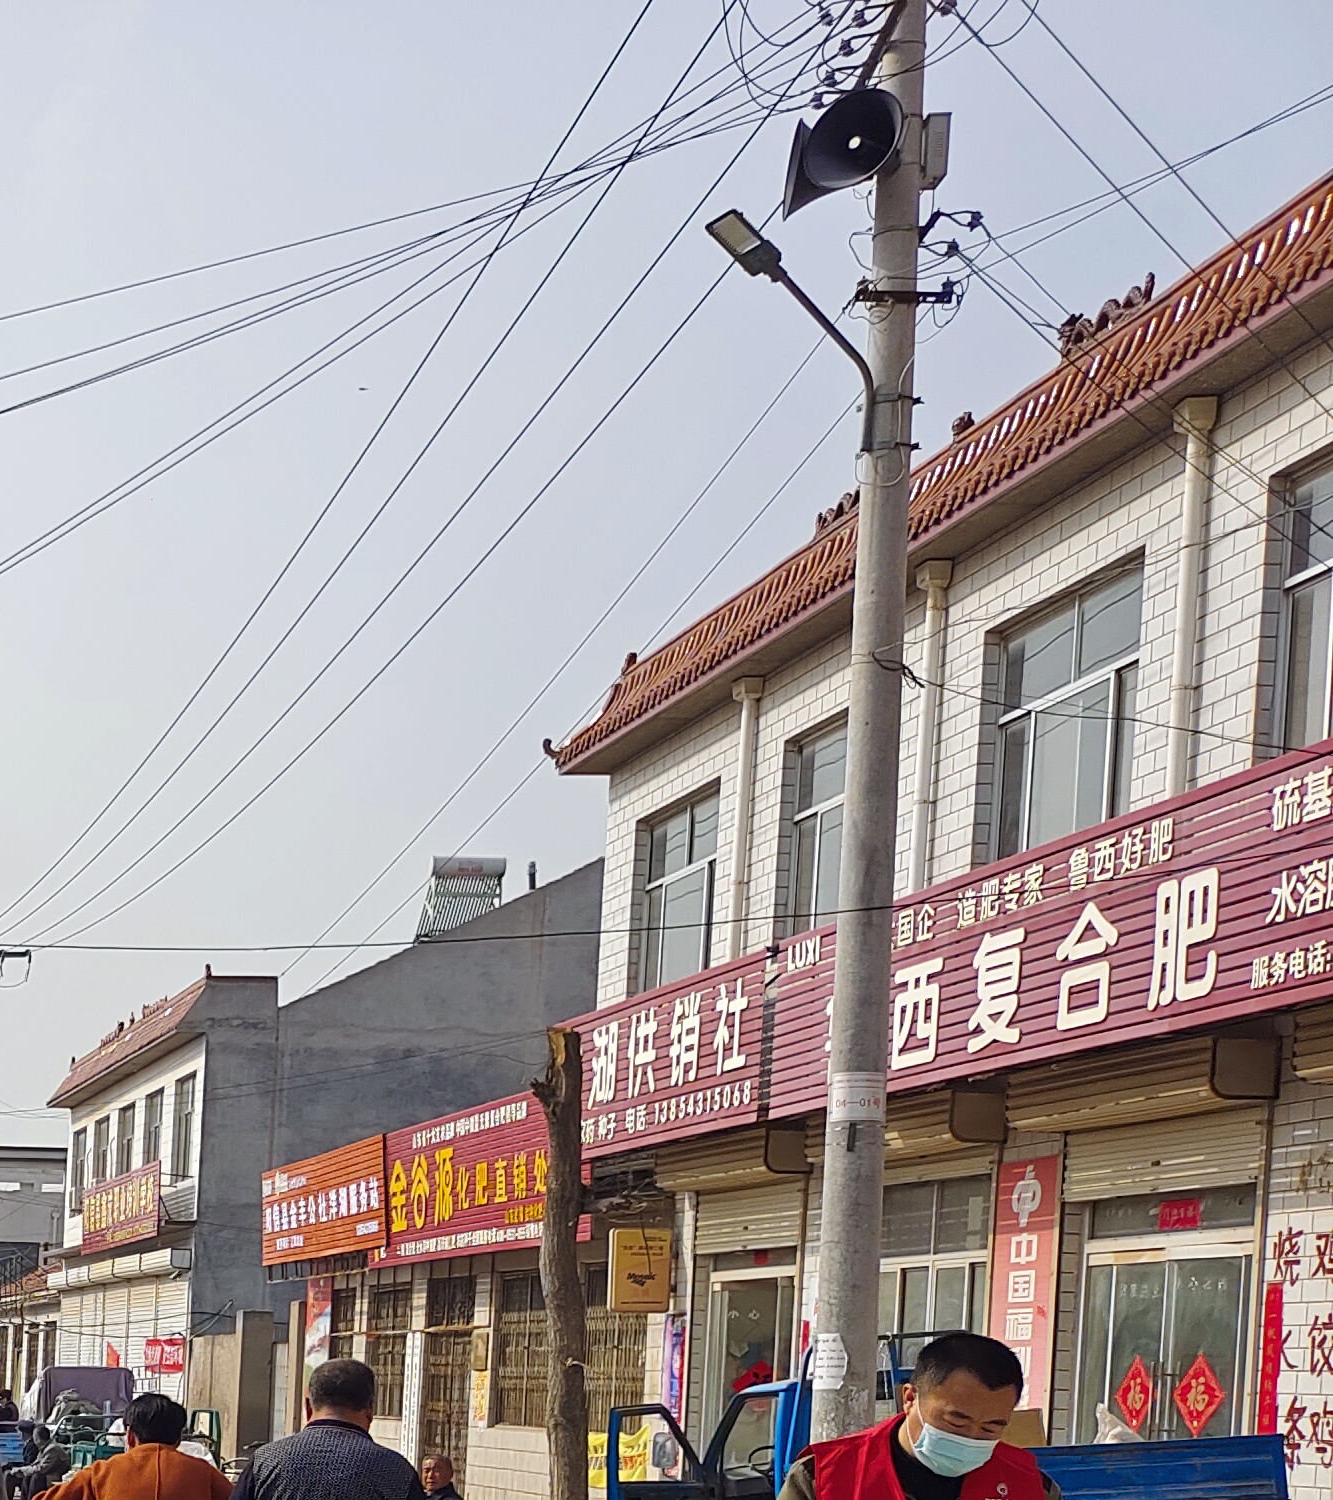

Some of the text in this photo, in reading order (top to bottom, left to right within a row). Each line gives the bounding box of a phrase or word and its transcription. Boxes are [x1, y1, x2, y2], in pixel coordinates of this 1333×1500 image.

[1272, 765, 1333, 832] 硫基
[891, 818, 1175, 949] 国企 造肥专家 鲁西好肥
[787, 936, 821, 971] LUXI
[825, 868, 1220, 1071] 西复合肥
[581, 978, 749, 1111] 湖供销社
[597, 1112, 617, 1140] 种子
[654, 1080, 751, 1125] 13854315068
[1127, 1377, 1145, 1417] 福
[1186, 1376, 1210, 1417] 福
